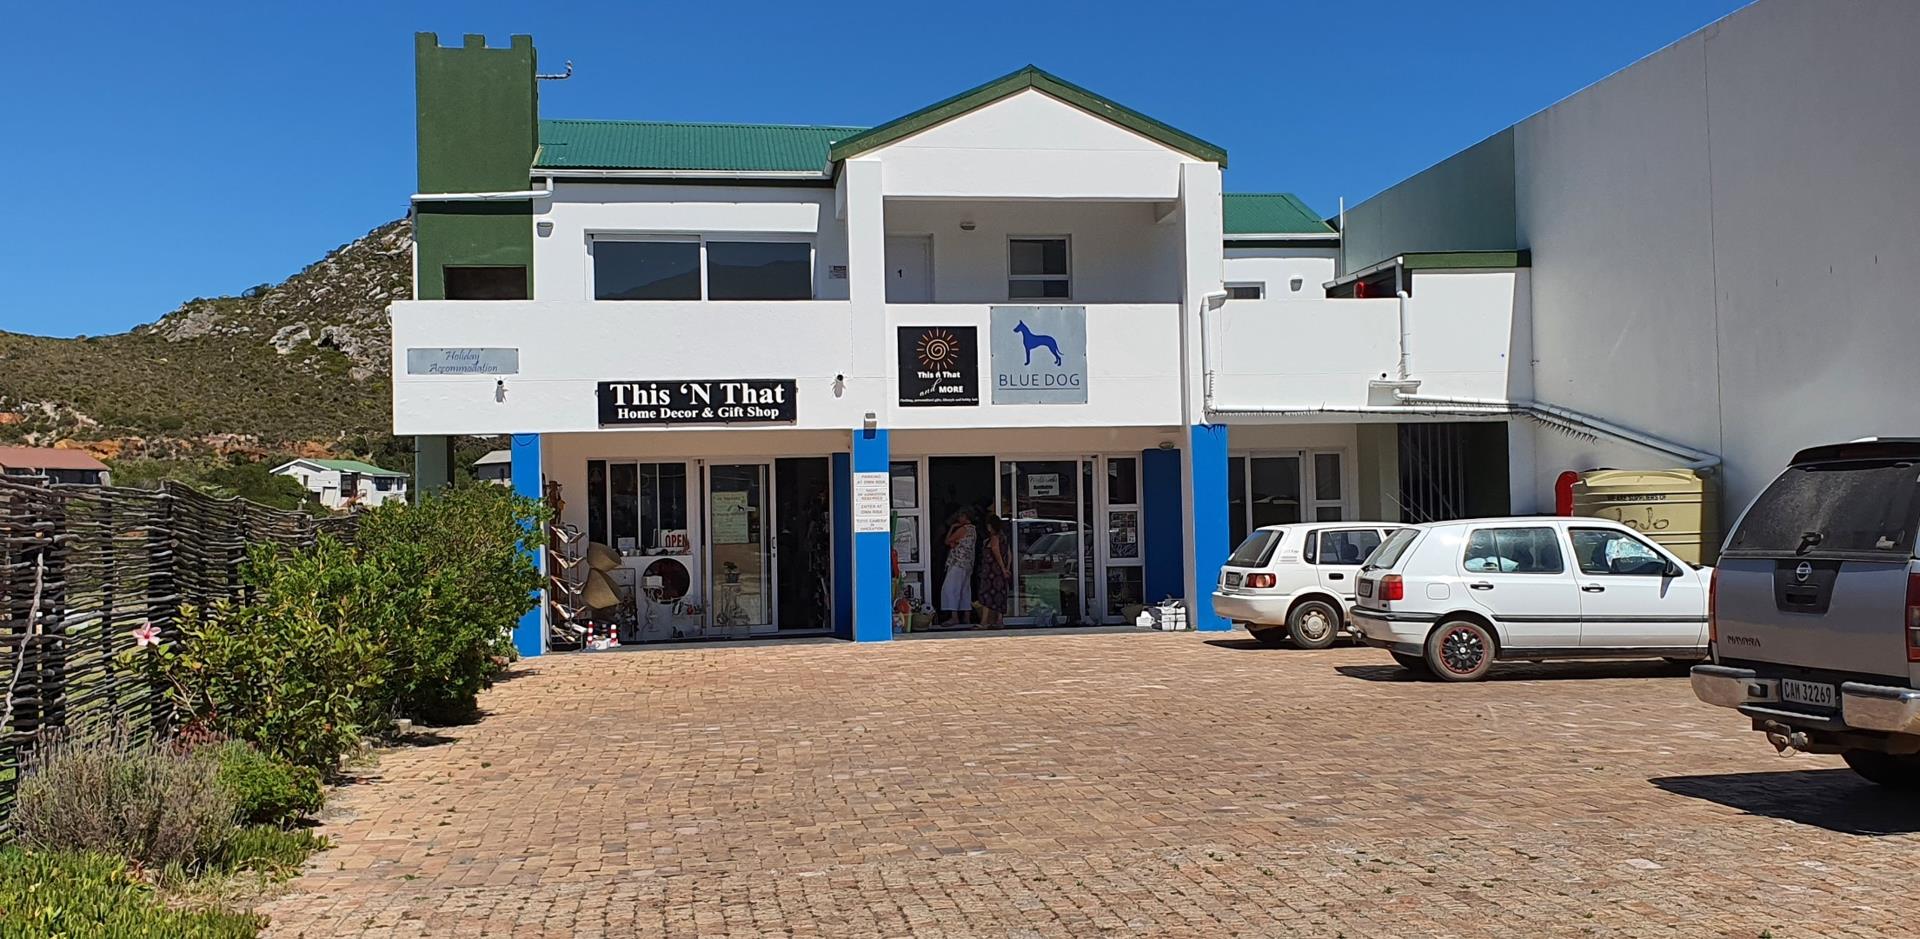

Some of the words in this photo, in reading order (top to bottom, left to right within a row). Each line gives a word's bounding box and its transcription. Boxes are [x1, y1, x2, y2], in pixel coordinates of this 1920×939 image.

[445, 349, 480, 365] Holiday
[429, 363, 498, 373] Accommodation
[917, 371, 934, 379] This
[942, 371, 961, 379] That
[999, 373, 1040, 387] BLUE
[1044, 373, 1080, 387] DOG
[610, 382, 671, 406] This
[719, 382, 785, 404] That
[938, 385, 964, 394] MORE
[618, 408, 656, 419] Home
[660, 407, 698, 419] Decor
[701, 407, 714, 419] &
[717, 406, 744, 418] Gift
[747, 406, 779, 419] Shop
[1615, 507, 1669, 530] JoJo
[665, 534, 688, 547] OPEN
[1727, 634, 1761, 647] NAVARA
[1784, 681, 1800, 700] CAM
[1802, 683, 1831, 704] 32269
